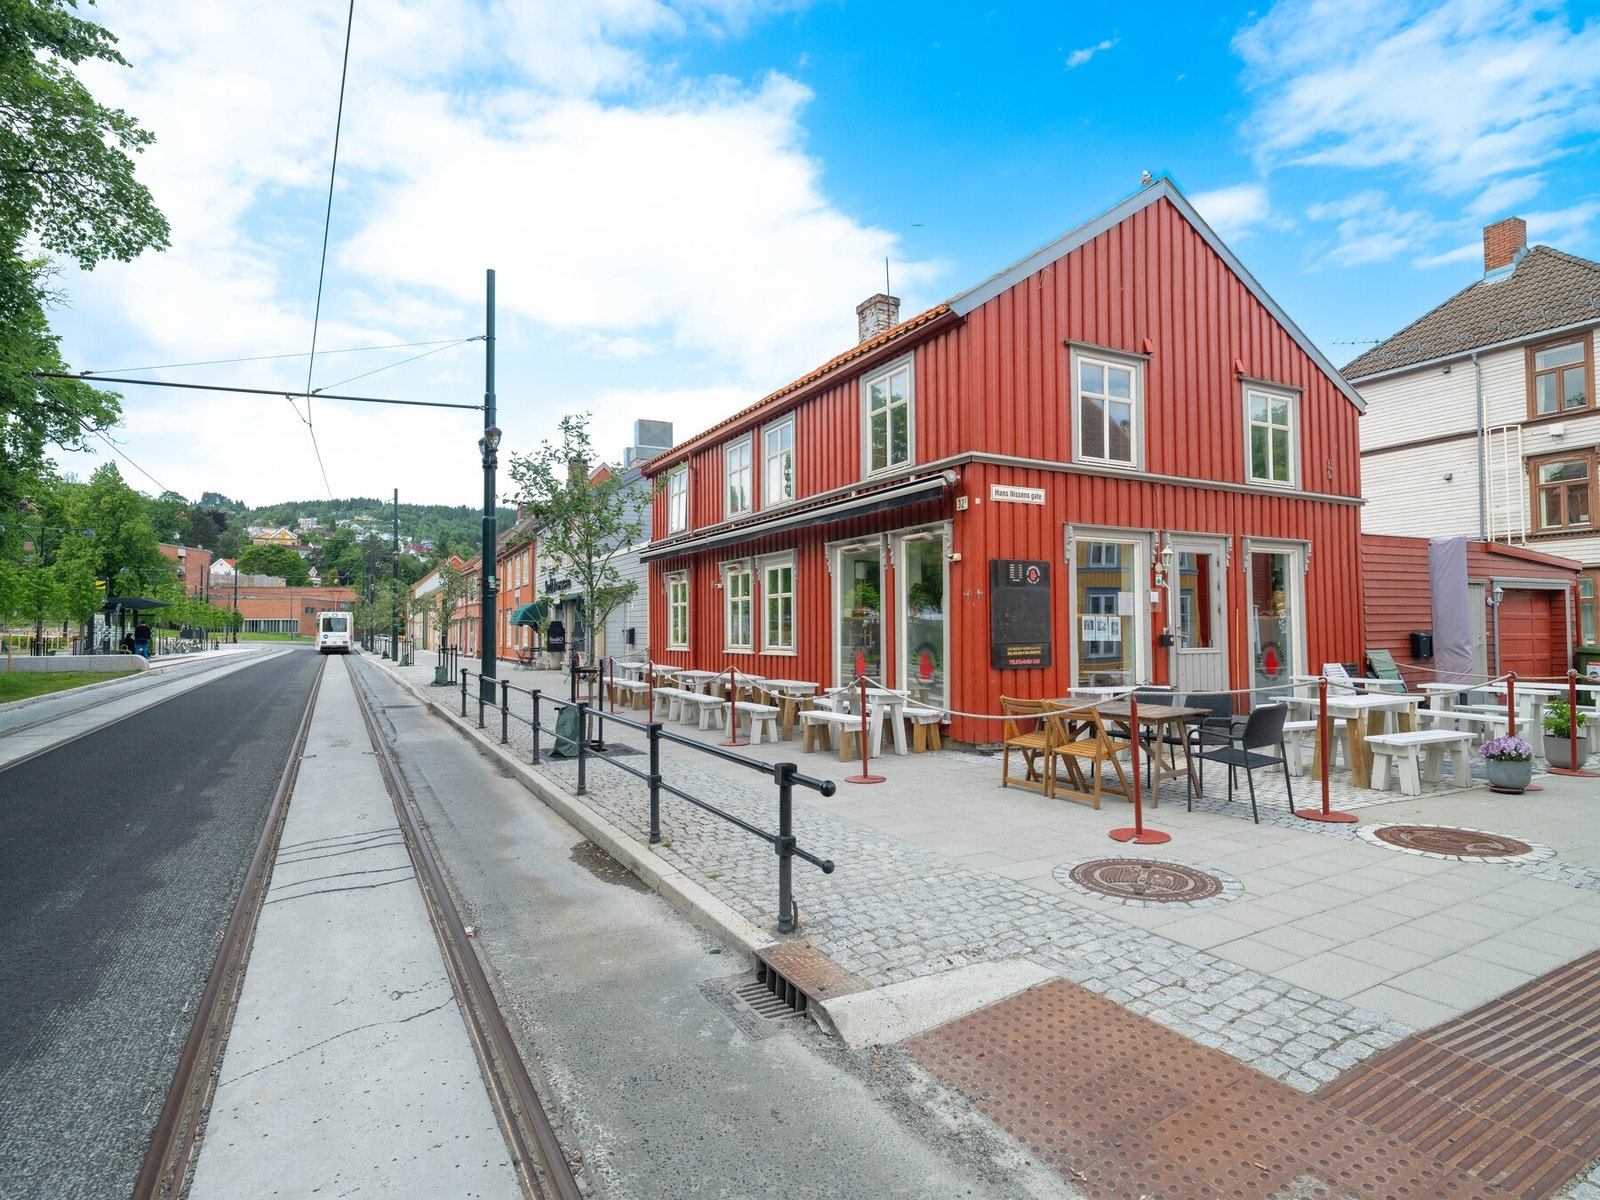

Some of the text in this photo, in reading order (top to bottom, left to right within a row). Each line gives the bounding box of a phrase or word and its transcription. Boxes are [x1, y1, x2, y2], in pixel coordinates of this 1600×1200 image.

[994, 488, 1042, 501] Hans Nissens gate
